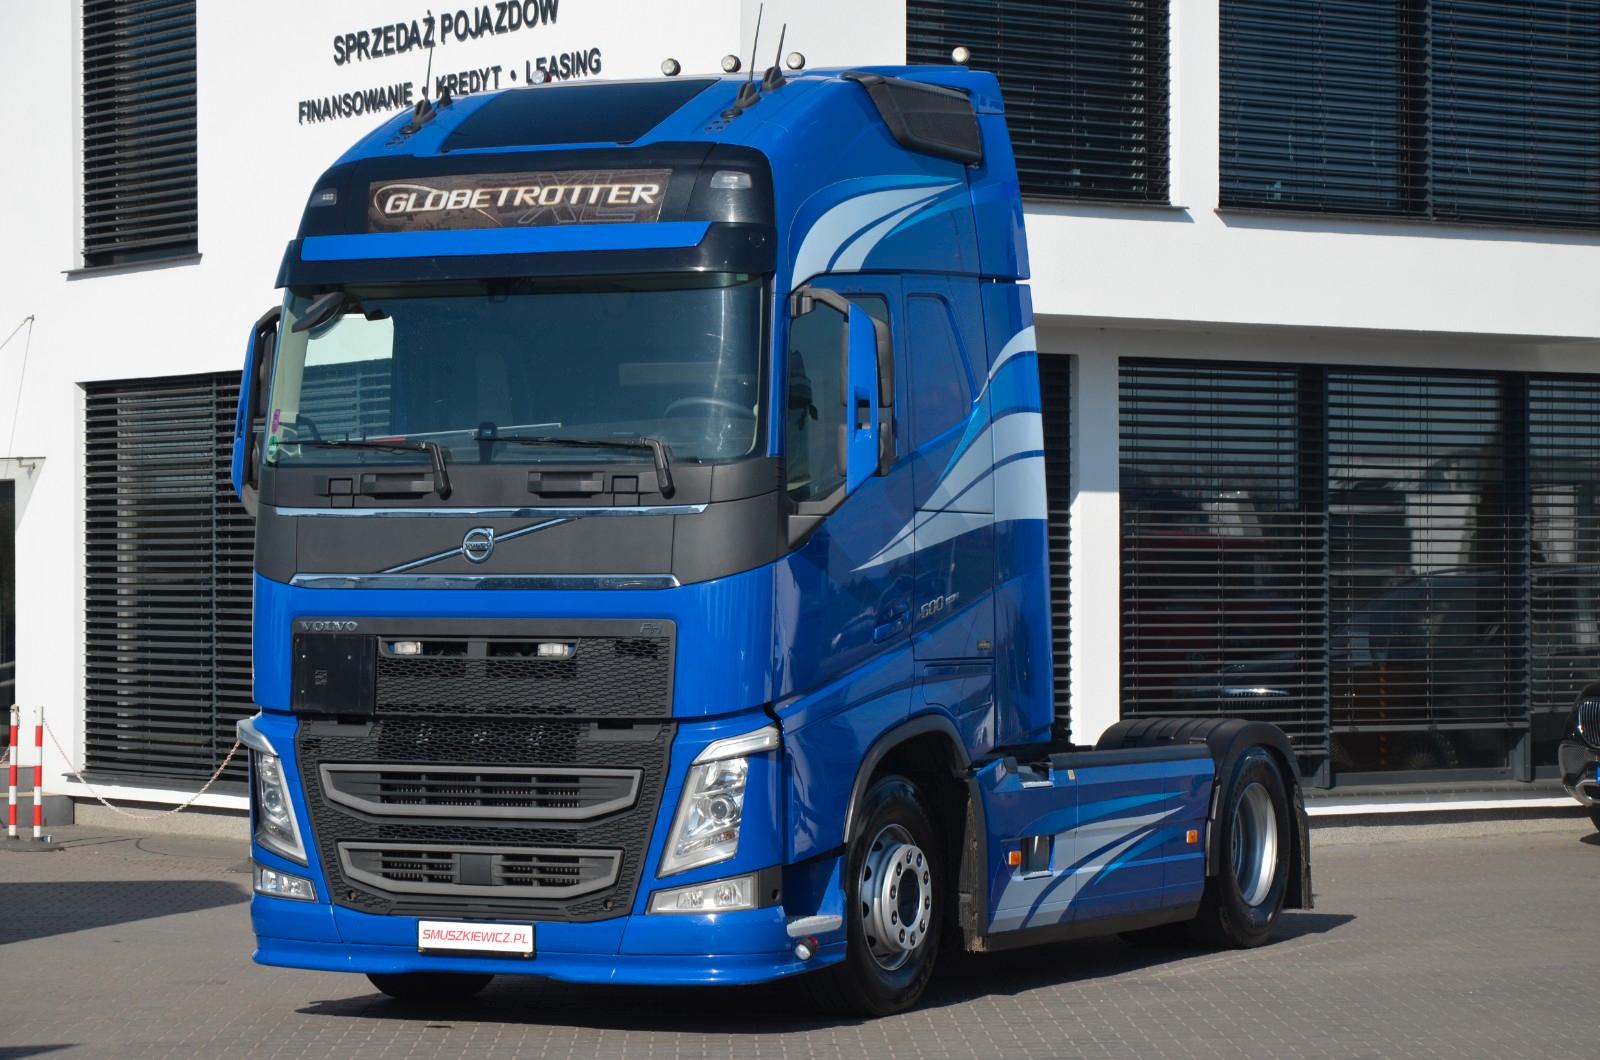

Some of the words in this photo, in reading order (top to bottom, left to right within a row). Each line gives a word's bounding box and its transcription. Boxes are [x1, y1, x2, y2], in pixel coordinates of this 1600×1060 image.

[298, 82, 413, 124] FINANSOWANIE
[436, 65, 502, 99] KREDYT
[384, 183, 660, 214] GLOBETROTTER
[303, 621, 358, 632] VOLVO
[422, 929, 529, 943] SMUSZKIEWICZ.PL
